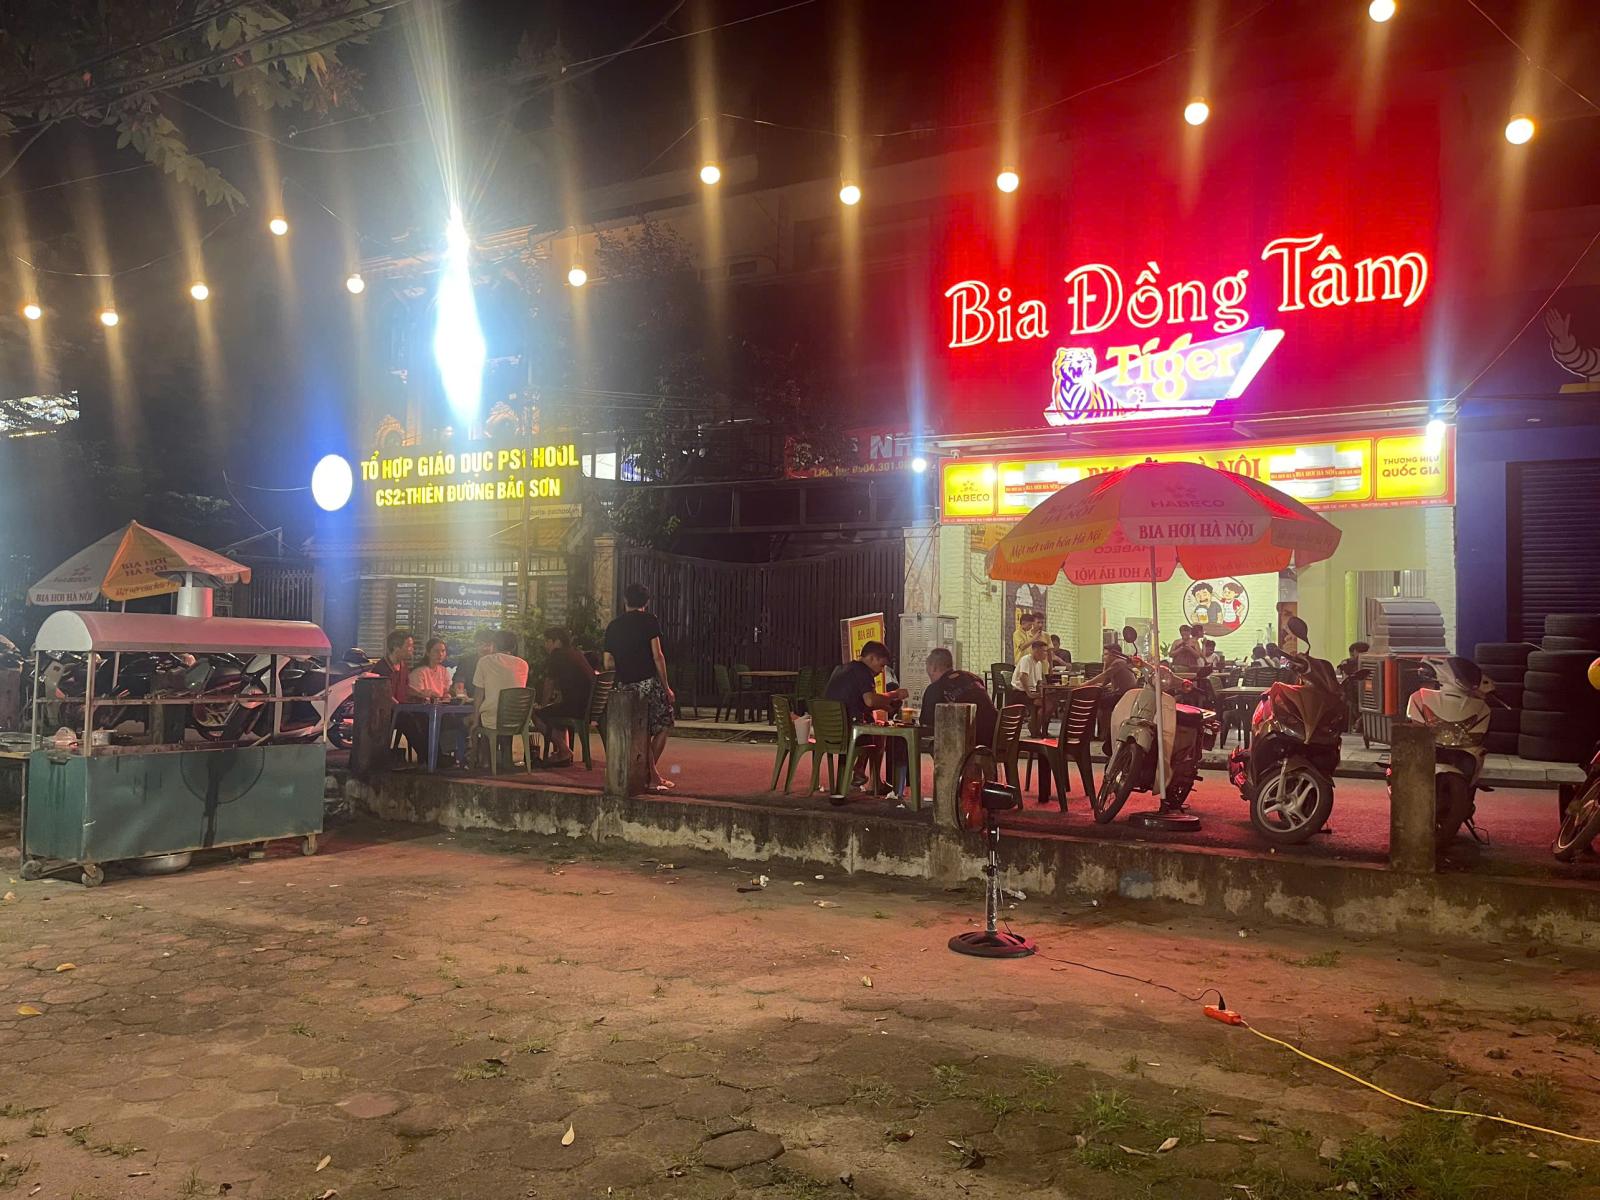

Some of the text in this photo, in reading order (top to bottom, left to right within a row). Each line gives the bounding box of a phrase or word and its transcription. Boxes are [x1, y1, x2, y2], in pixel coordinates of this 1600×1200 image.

[944, 233, 1428, 348] Bia Đồng Tâm
[1106, 333, 1245, 402] Tiger
[361, 451, 380, 480] TỔ
[382, 457, 413, 482] HỢP
[418, 450, 455, 477] GIÁO
[460, 451, 493, 477] DỤC
[1420, 466, 1441, 476] GIA
[529, 476, 561, 499] SƠN
[948, 493, 990, 503] HABECO
[1139, 524, 1165, 540] BIA
[1168, 522, 1196, 539] HƠI
[1200, 519, 1224, 538] HÀ
[1226, 520, 1255, 541] NỘI
[36, 593, 50, 602] BIA
